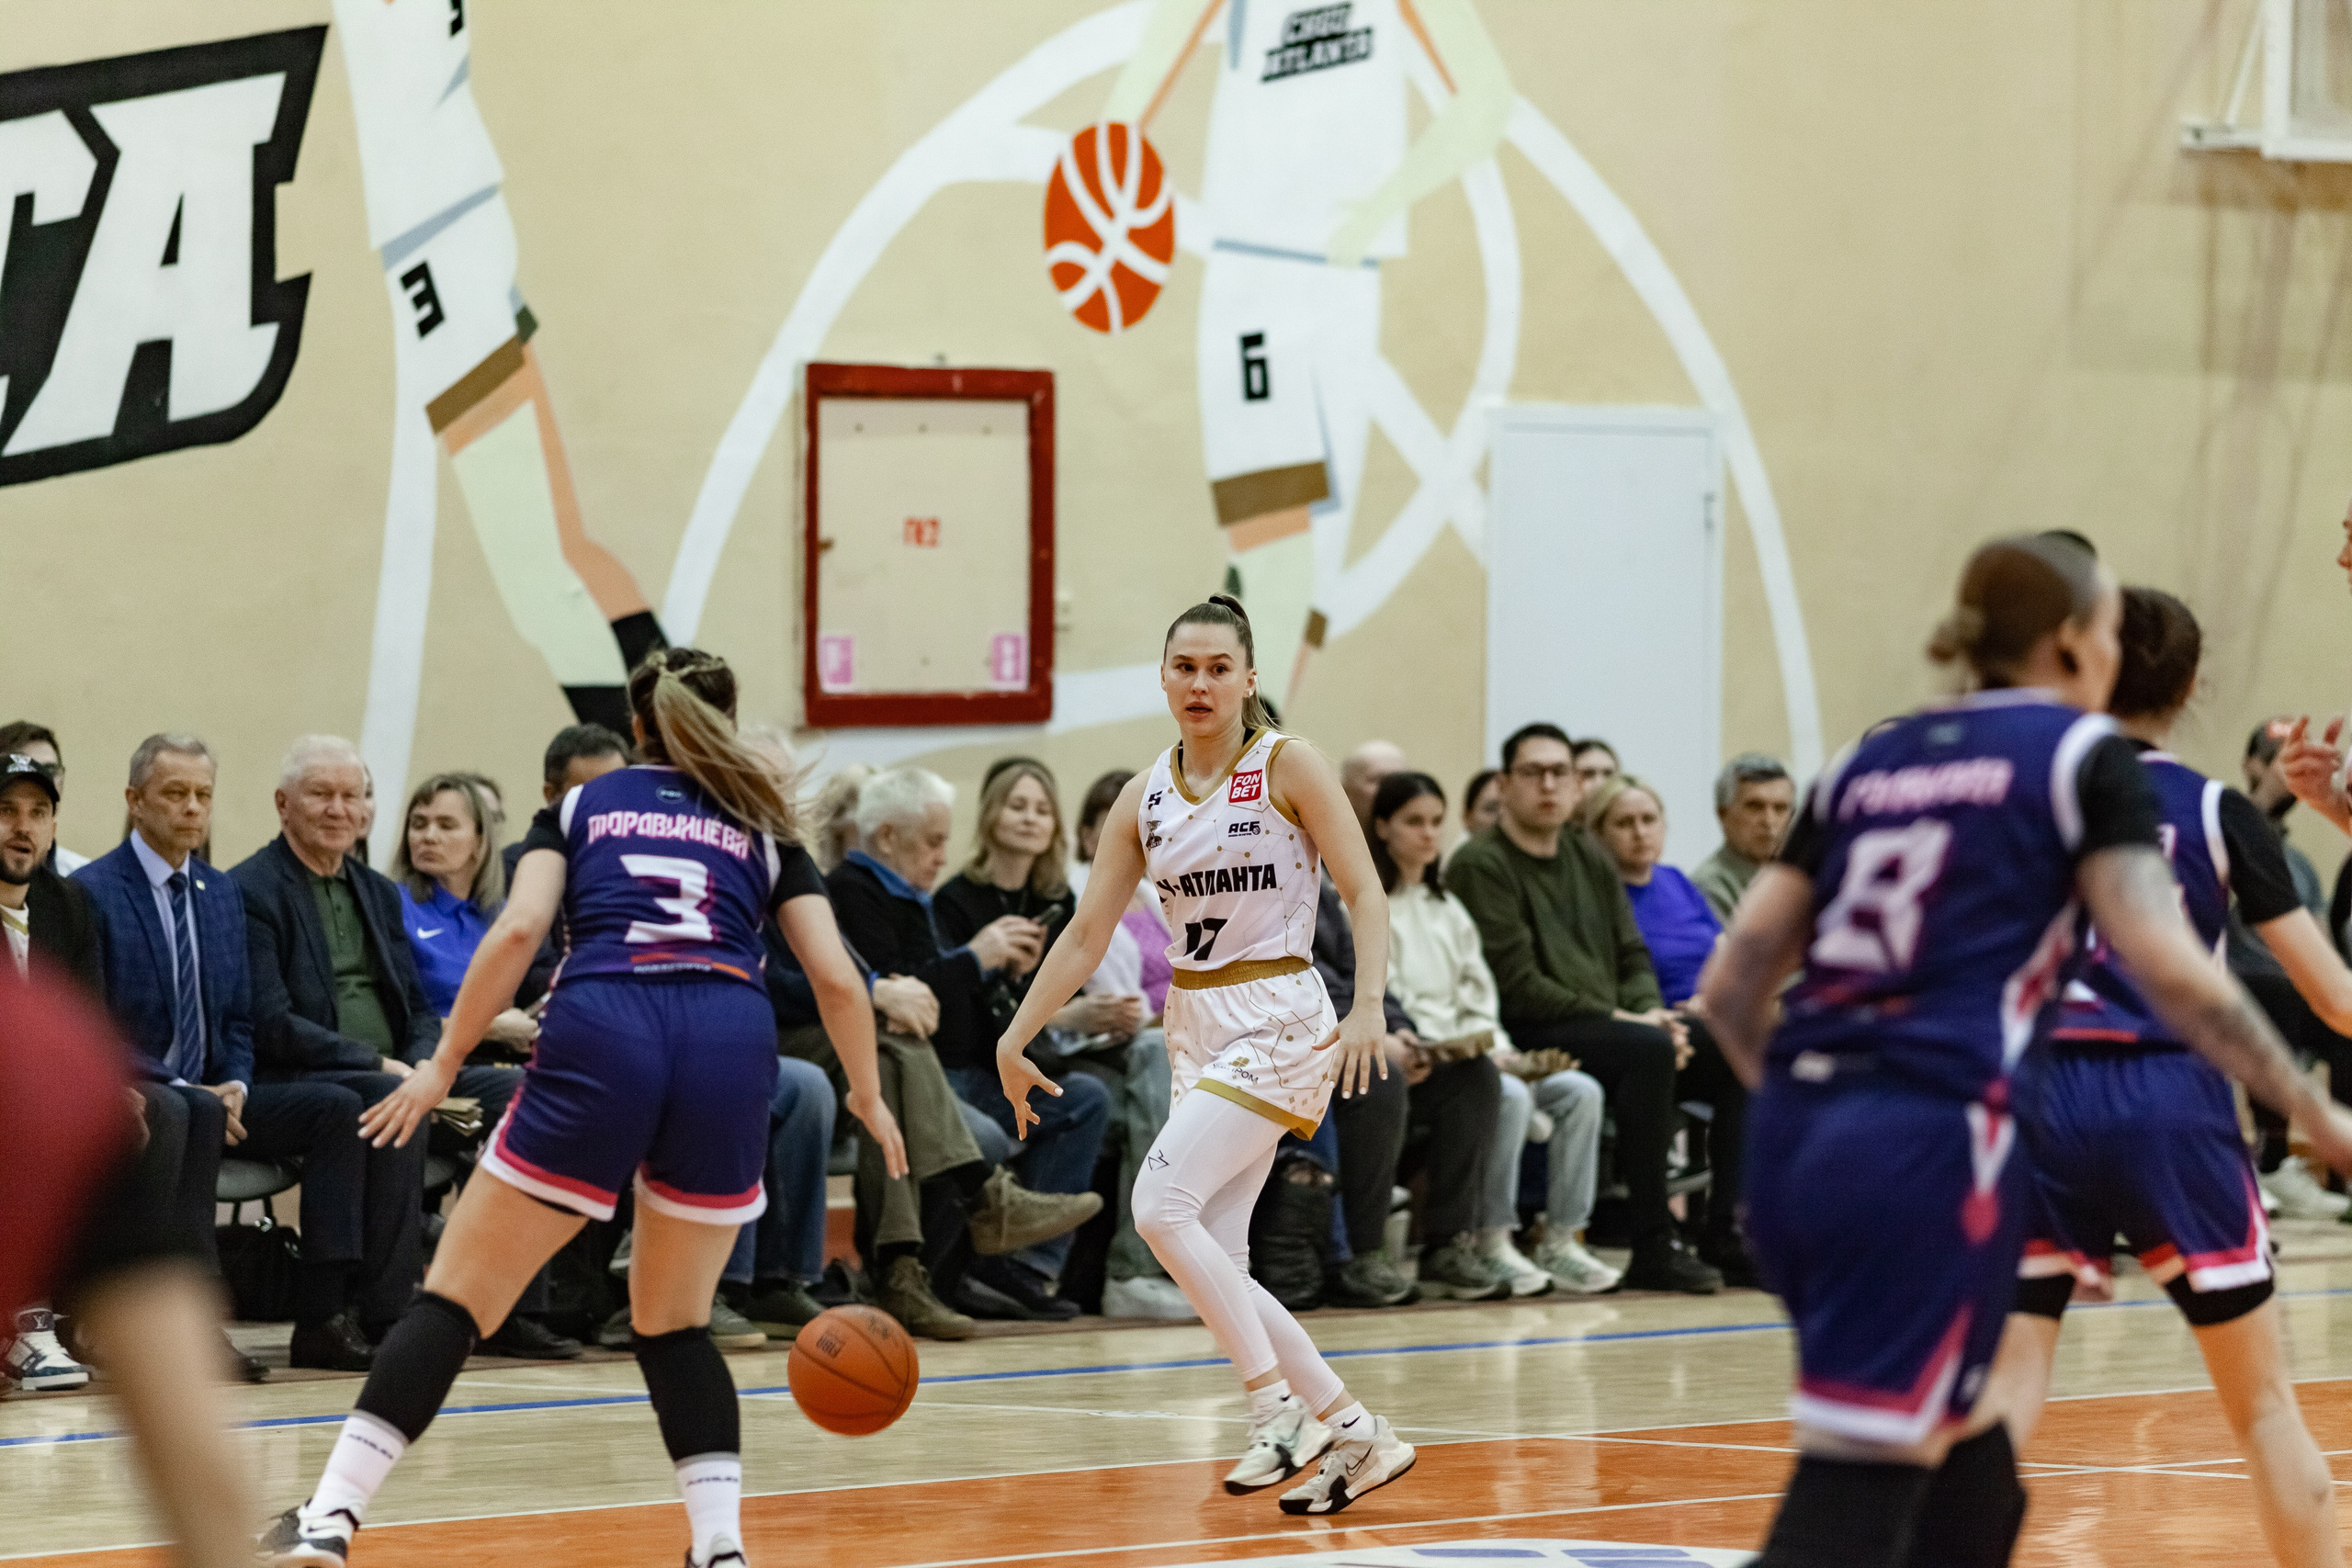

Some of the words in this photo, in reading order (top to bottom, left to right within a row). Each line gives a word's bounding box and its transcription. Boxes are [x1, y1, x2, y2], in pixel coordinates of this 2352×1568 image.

[399, 260, 445, 340] 3
[1238, 332, 1270, 400] 6
[1231, 784, 1260, 799] BET
[1233, 772, 1261, 787] FON
[619, 853, 715, 944] 3
[1156, 863, 1277, 904] У-АТЛАНТА
[1183, 918, 1228, 962] 17
